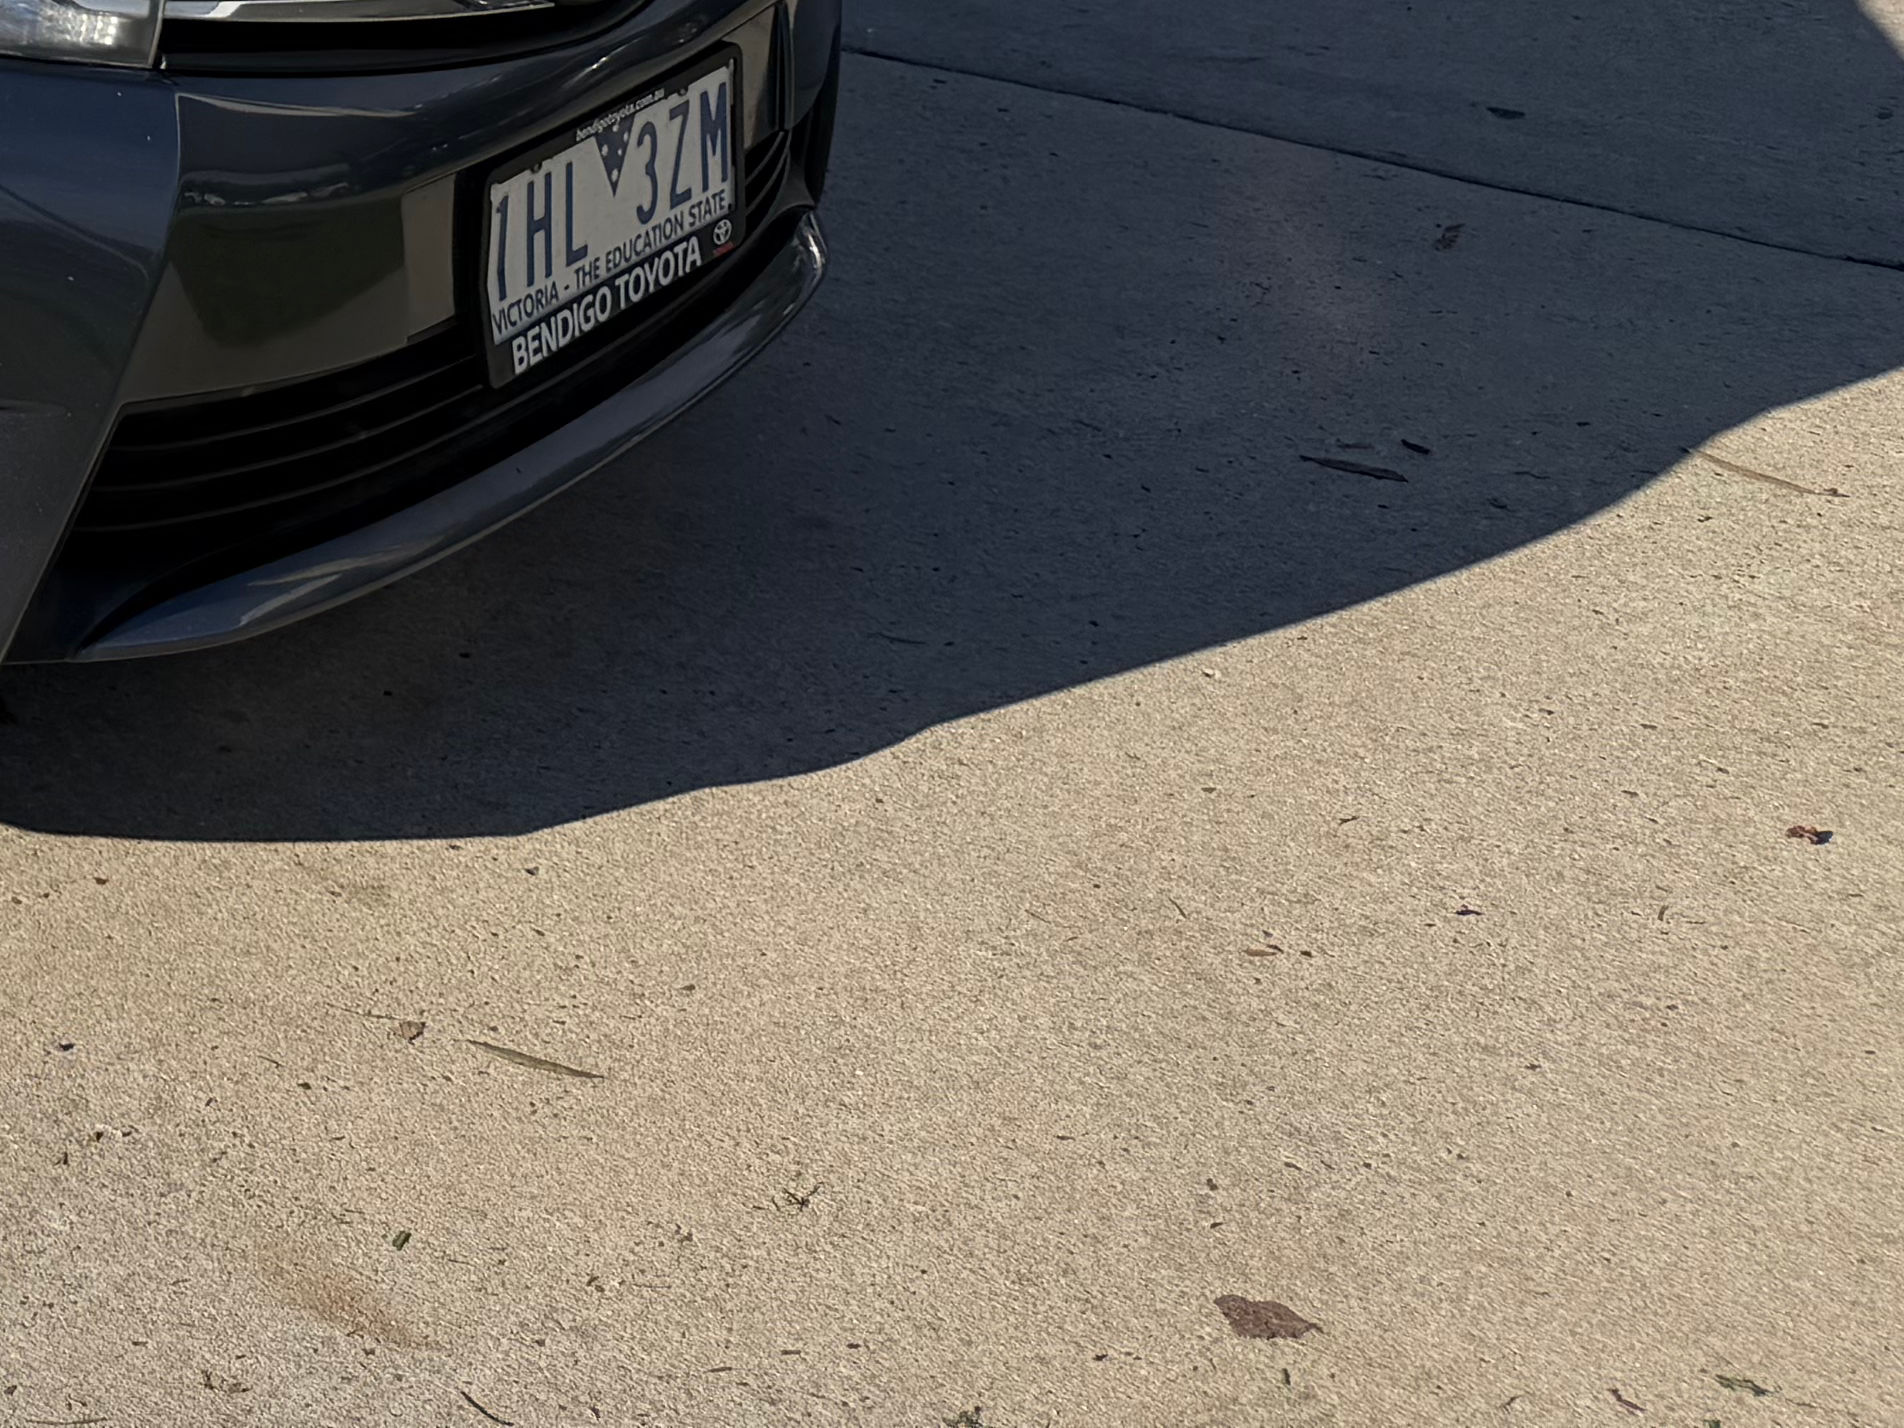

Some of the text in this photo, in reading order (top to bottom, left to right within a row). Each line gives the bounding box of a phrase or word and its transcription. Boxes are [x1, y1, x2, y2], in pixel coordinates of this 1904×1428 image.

[492, 281, 559, 336] VICTORIA
[574, 256, 600, 290] THE
[606, 217, 682, 275] EDUCATION
[689, 189, 726, 228] STATE
[511, 236, 702, 375] BENDIGO TOYOTA
